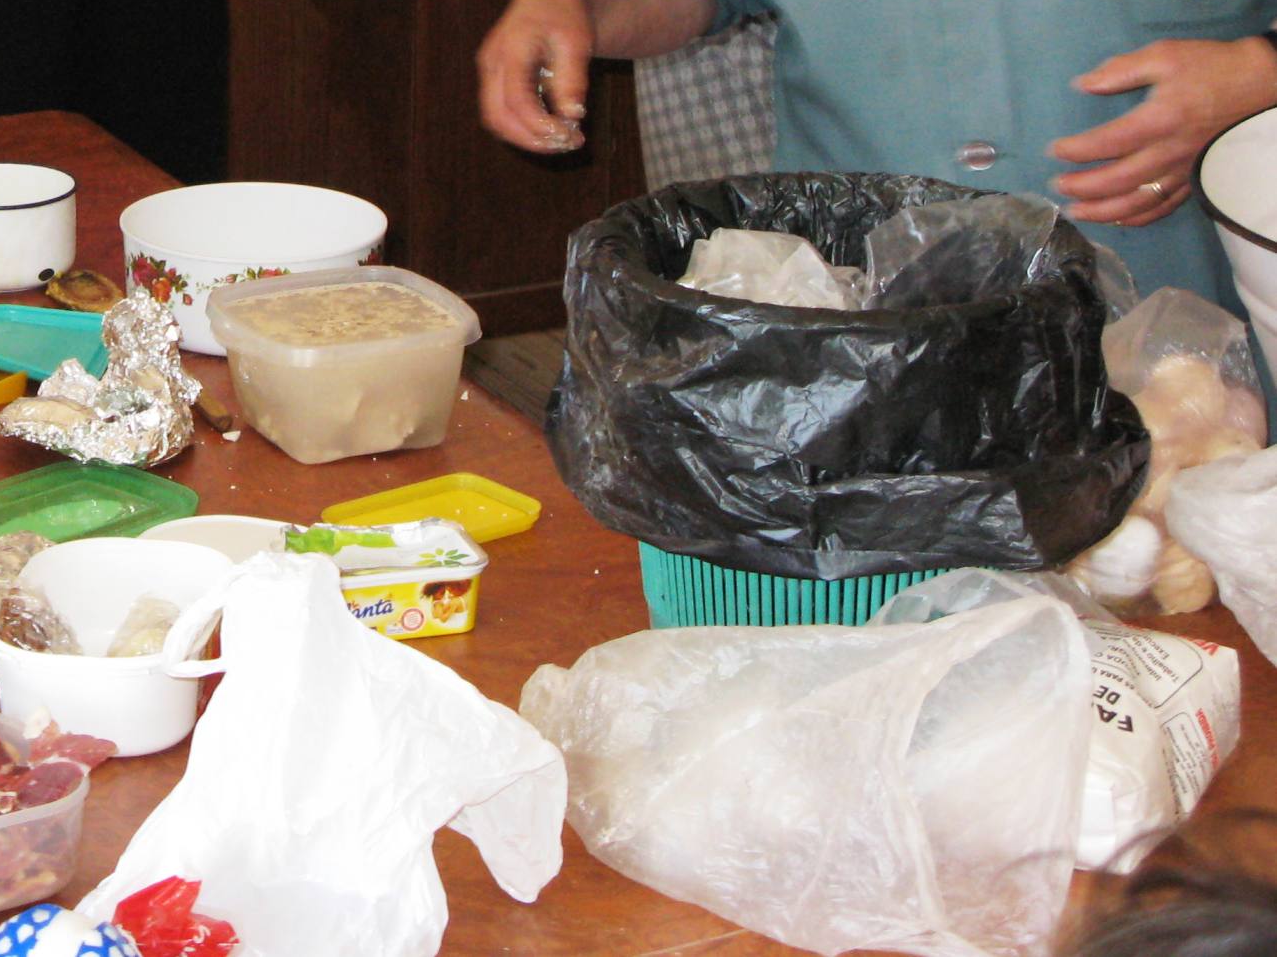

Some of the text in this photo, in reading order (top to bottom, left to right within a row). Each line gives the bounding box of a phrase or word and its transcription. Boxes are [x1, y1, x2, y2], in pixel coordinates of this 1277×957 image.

[346, 596, 395, 620] anta
[1091, 684, 1121, 706] DE
[1090, 701, 1135, 734] FA
